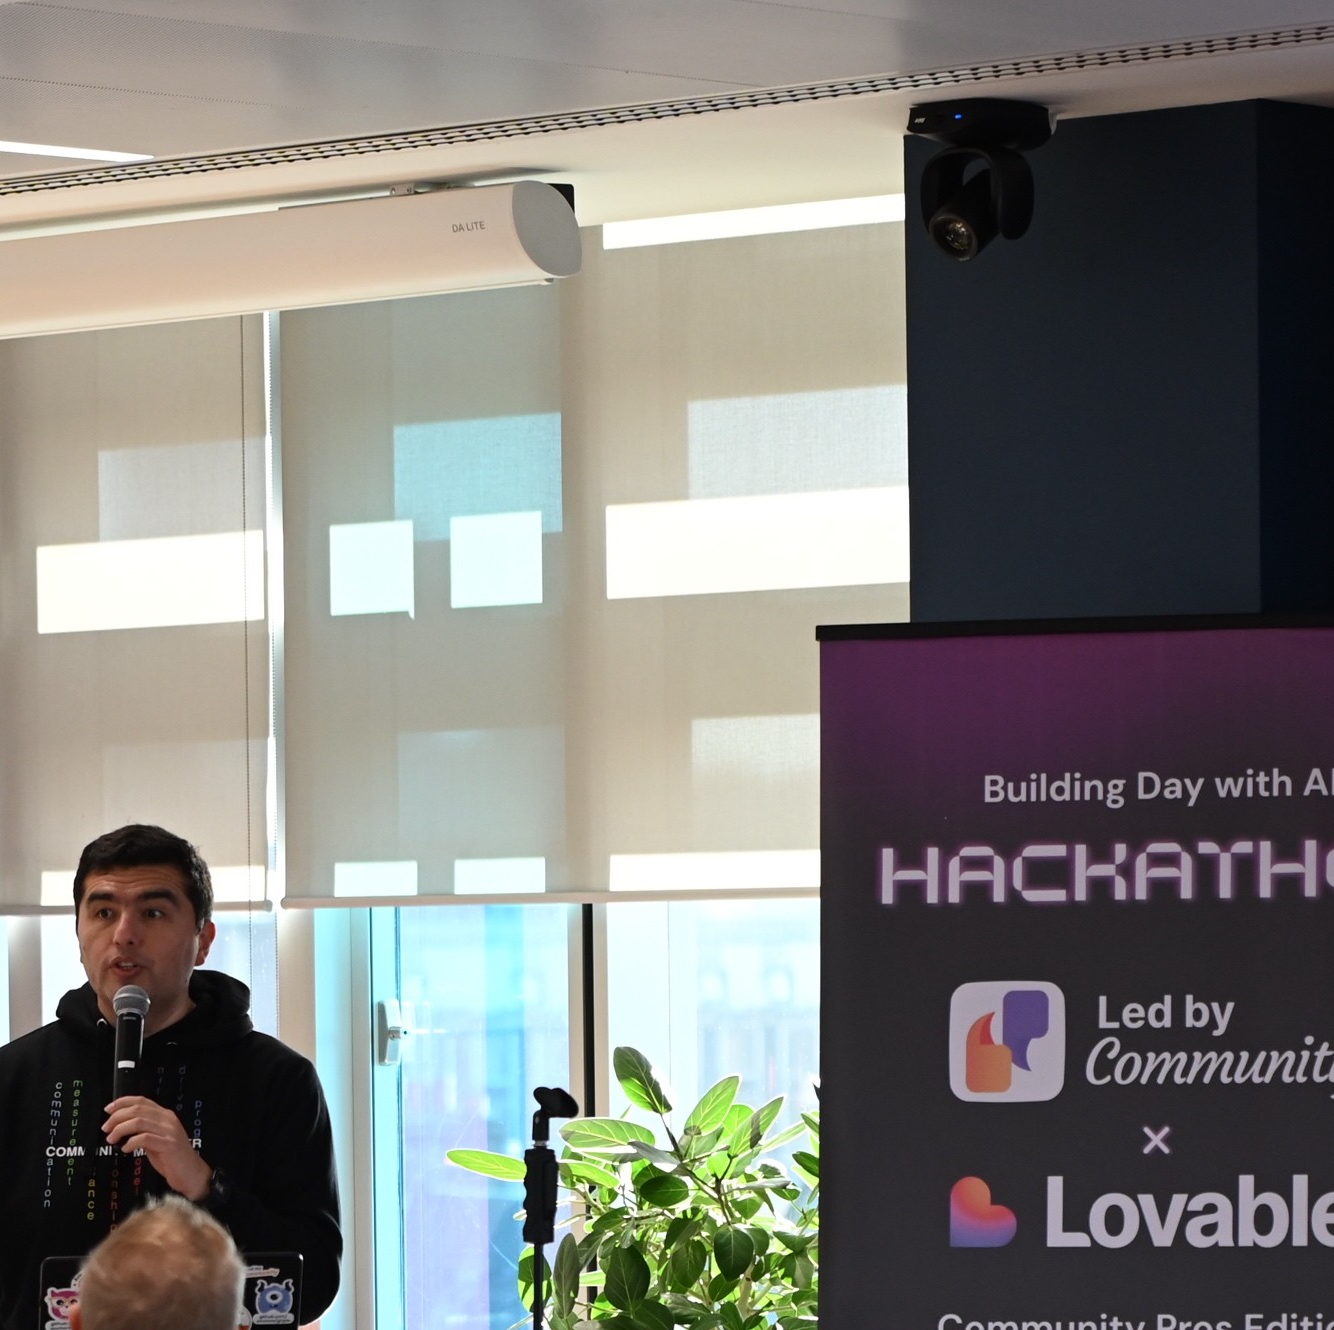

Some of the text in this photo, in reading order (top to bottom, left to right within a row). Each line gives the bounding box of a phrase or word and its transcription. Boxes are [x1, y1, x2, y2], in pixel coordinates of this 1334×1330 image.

[983, 770, 1125, 809] Building
[1136, 769, 1204, 806] Day
[1214, 767, 1292, 799] with
[1098, 994, 1236, 1036] Led by
